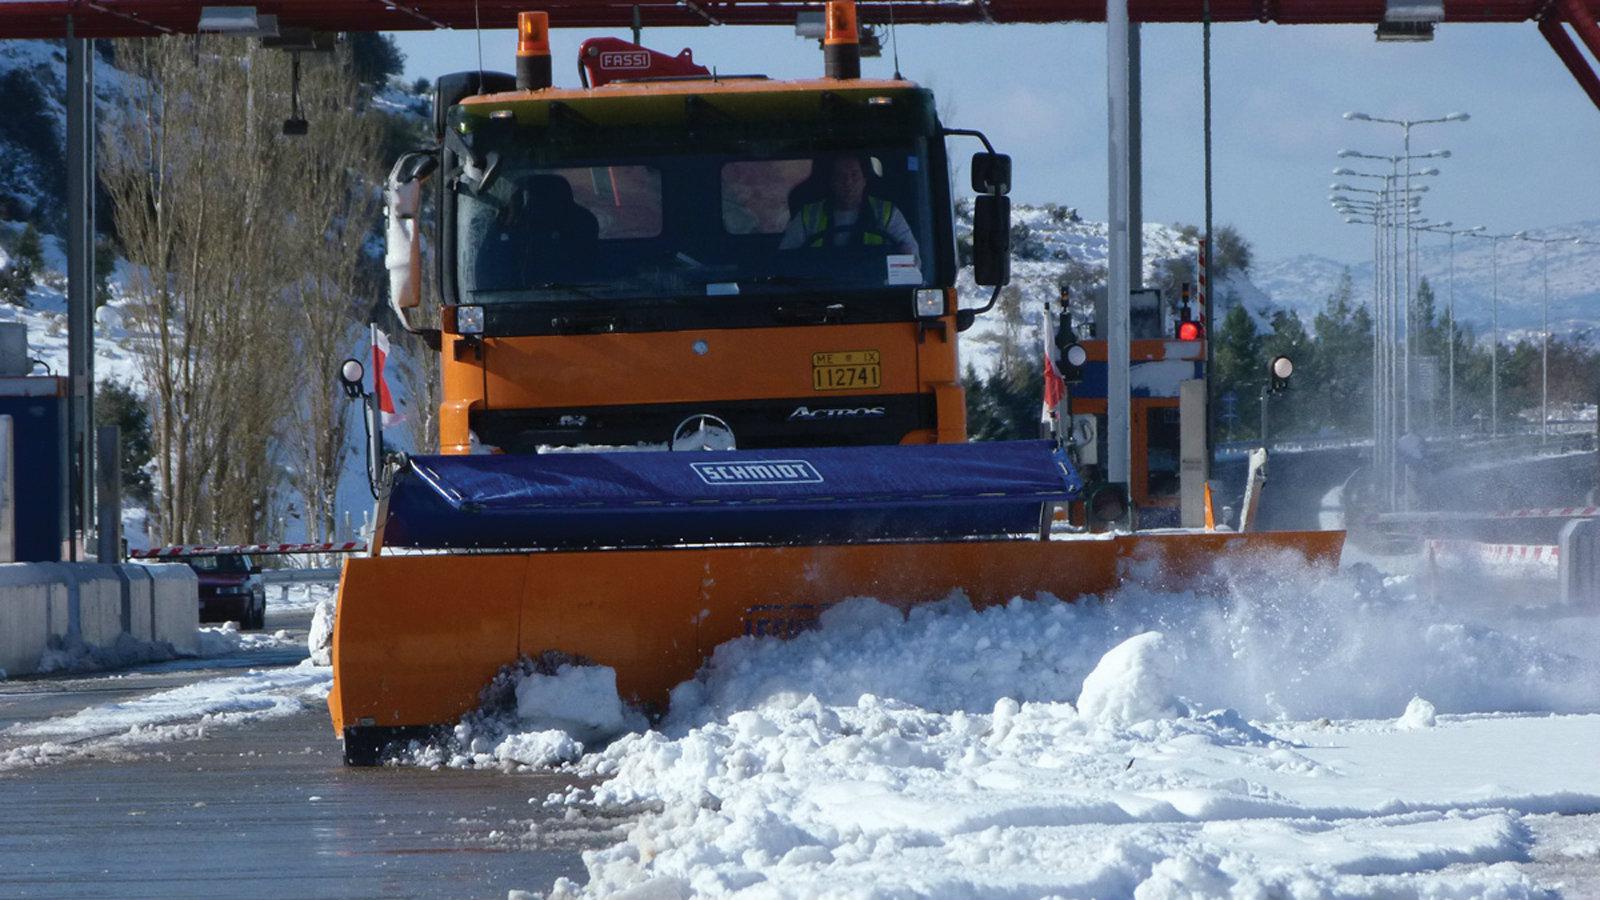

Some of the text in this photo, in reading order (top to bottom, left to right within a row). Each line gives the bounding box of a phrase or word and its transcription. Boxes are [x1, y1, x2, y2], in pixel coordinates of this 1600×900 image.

[604, 54, 647, 67] FASSI
[816, 367, 878, 387] 112741
[702, 464, 809, 480] SCHMIDT
